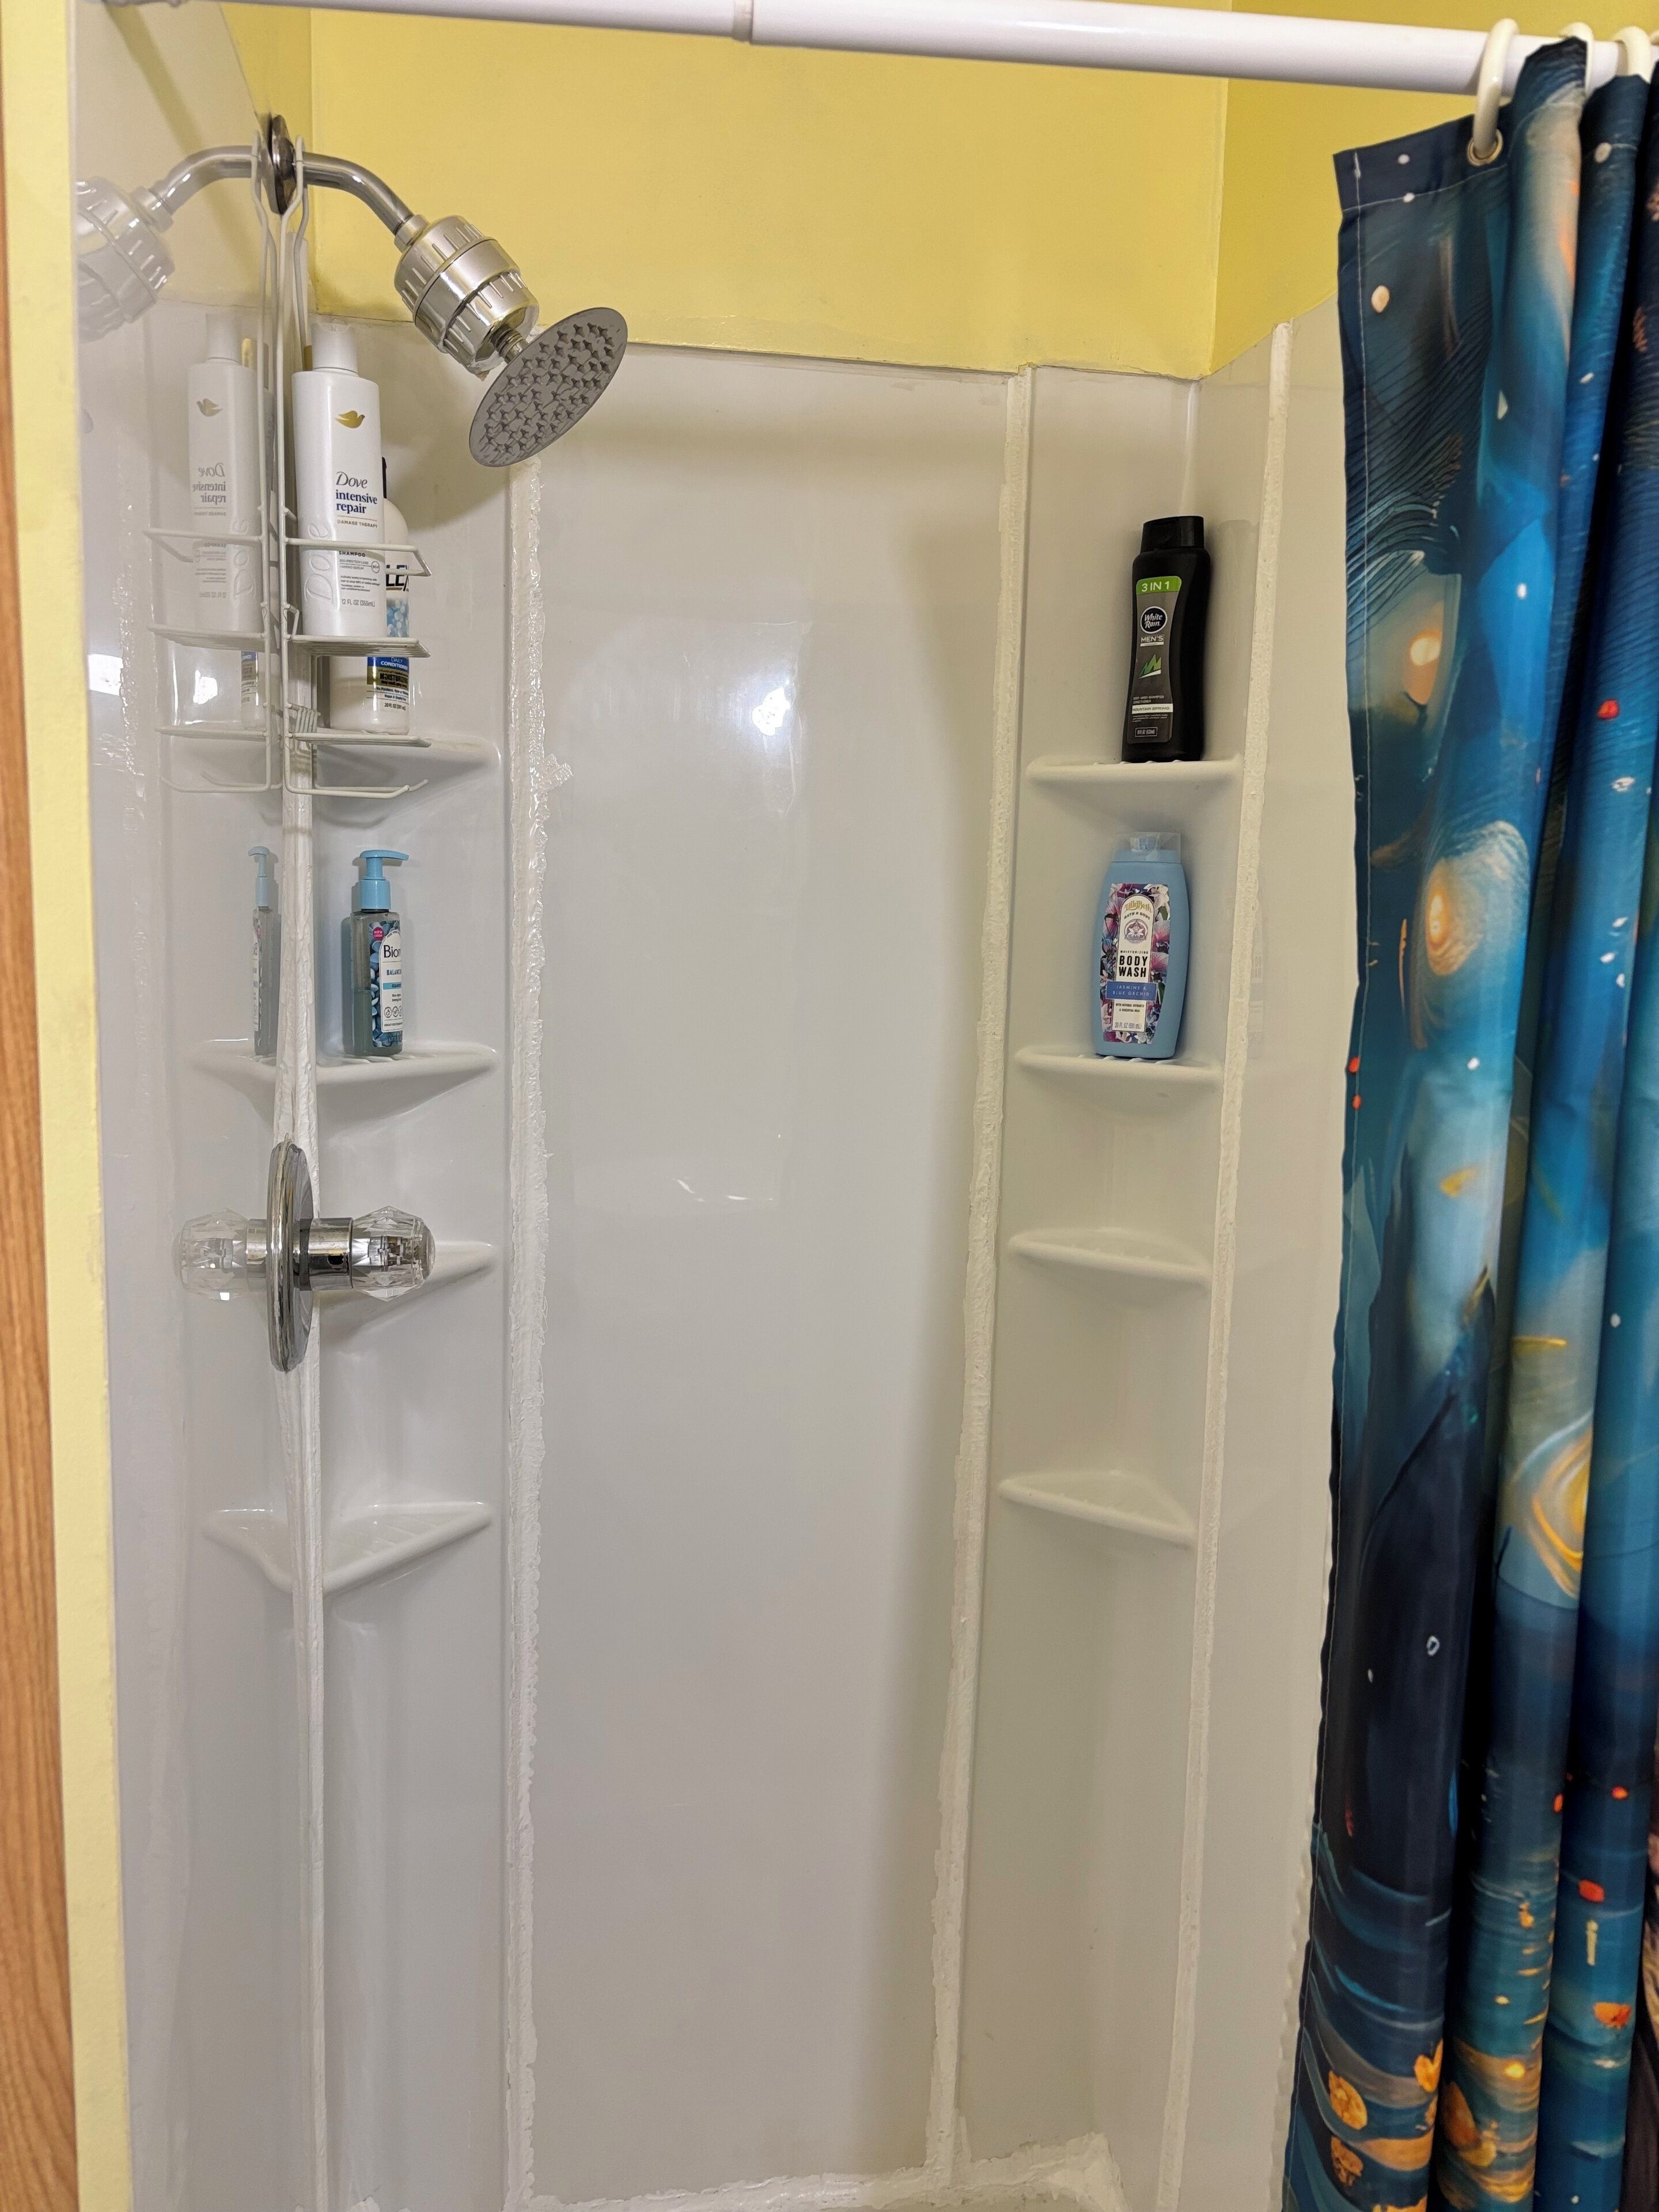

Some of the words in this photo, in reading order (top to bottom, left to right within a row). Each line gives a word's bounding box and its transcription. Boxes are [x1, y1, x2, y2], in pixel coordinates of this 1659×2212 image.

[336, 471, 368, 488] Dove
[335, 489, 378, 505] intensive
[336, 503, 367, 514] repair
[1142, 583, 1148, 592] 3
[1150, 581, 1162, 591] IN
[1165, 581, 1170, 590] 1
[1144, 613, 1163, 622] White
[1145, 620, 1160, 629] Rain
[1119, 955, 1148, 966] BODY
[1119, 967, 1147, 978] WASH
